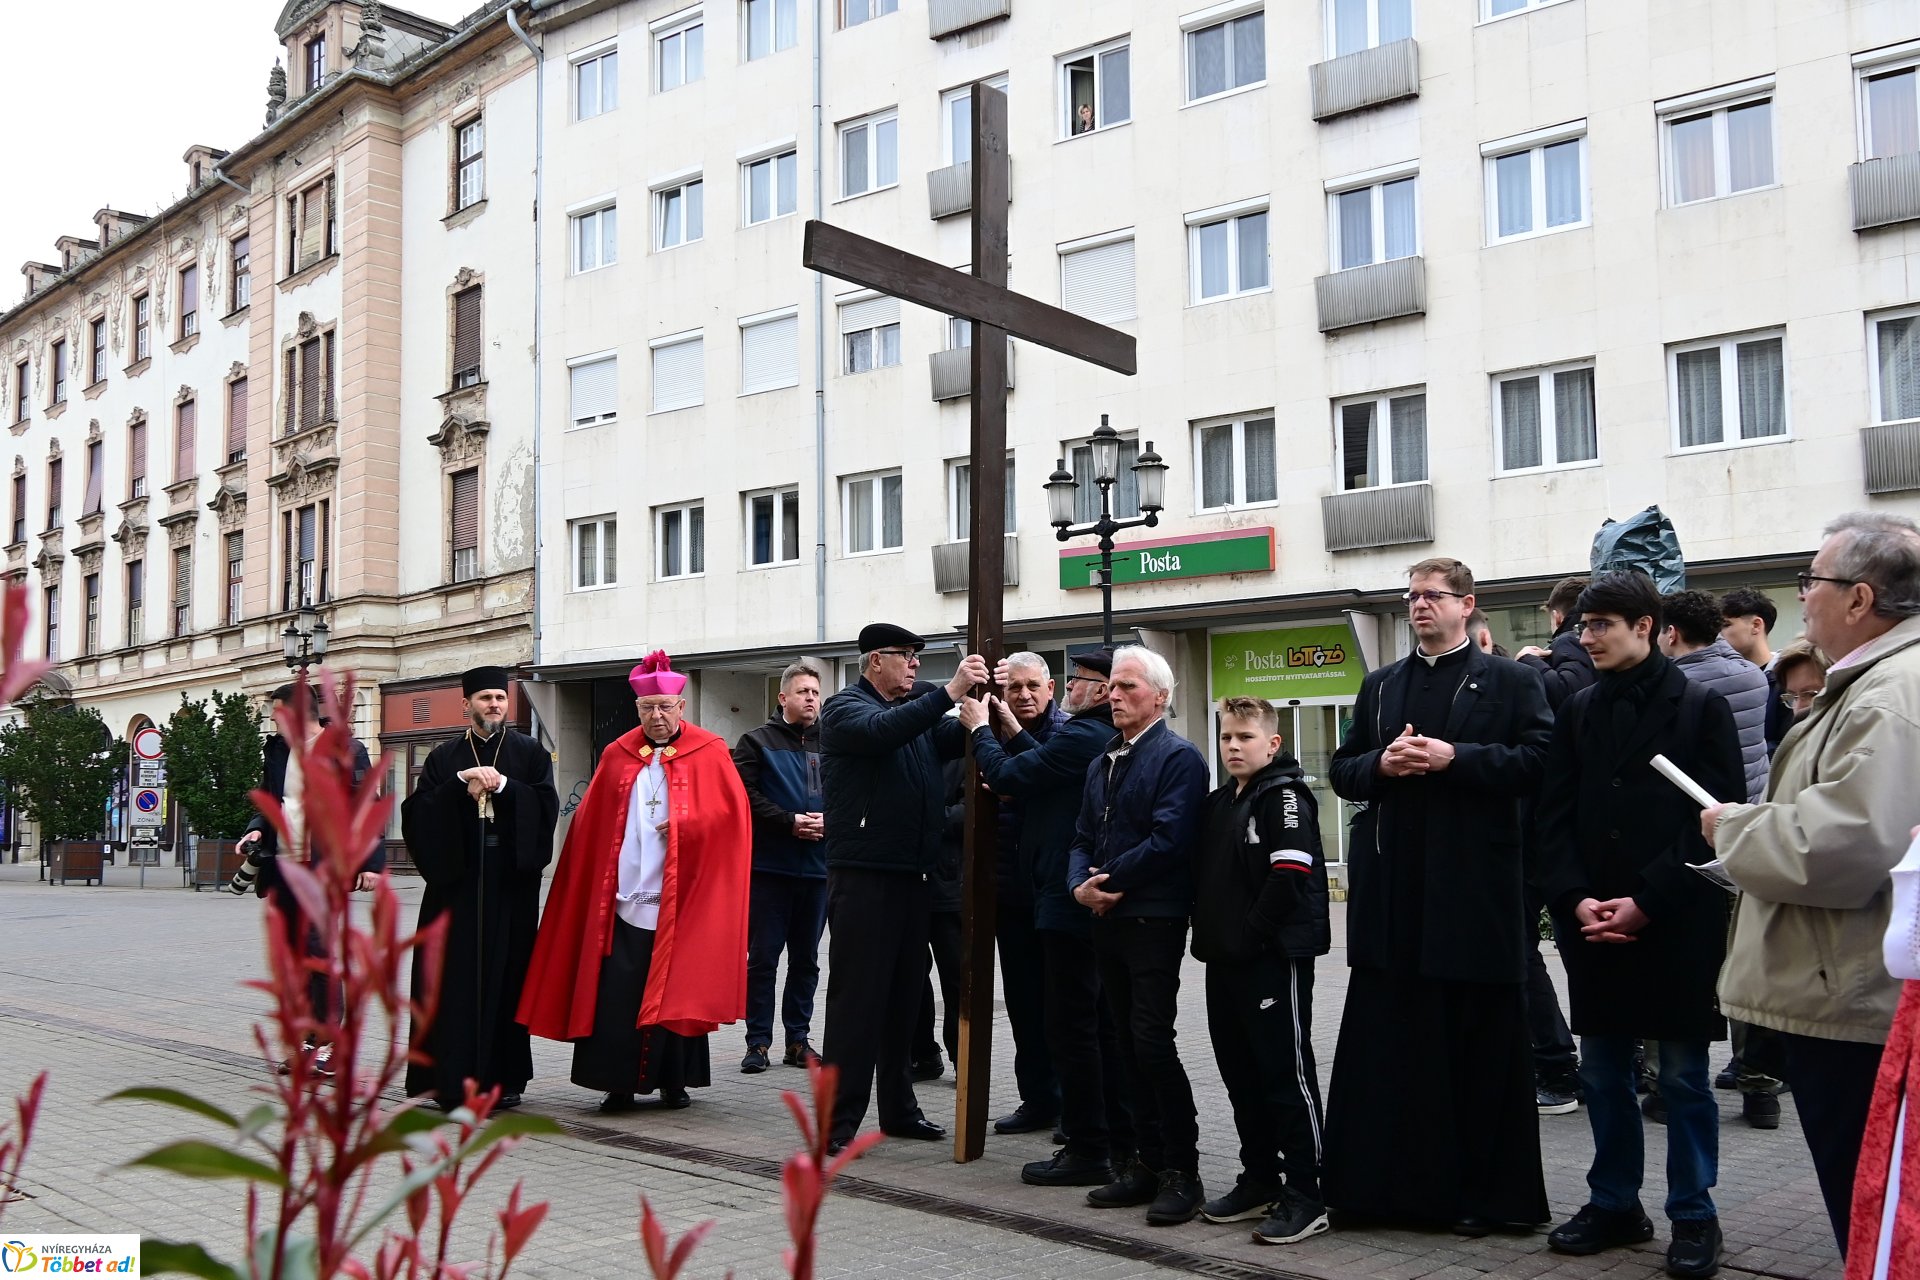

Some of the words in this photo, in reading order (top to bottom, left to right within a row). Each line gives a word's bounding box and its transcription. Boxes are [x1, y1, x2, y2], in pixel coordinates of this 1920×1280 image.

[1140, 551, 1181, 574] Posta
[1244, 650, 1285, 671] Posta
[1285, 670, 1346, 681] NYITVATARTÁSSAL
